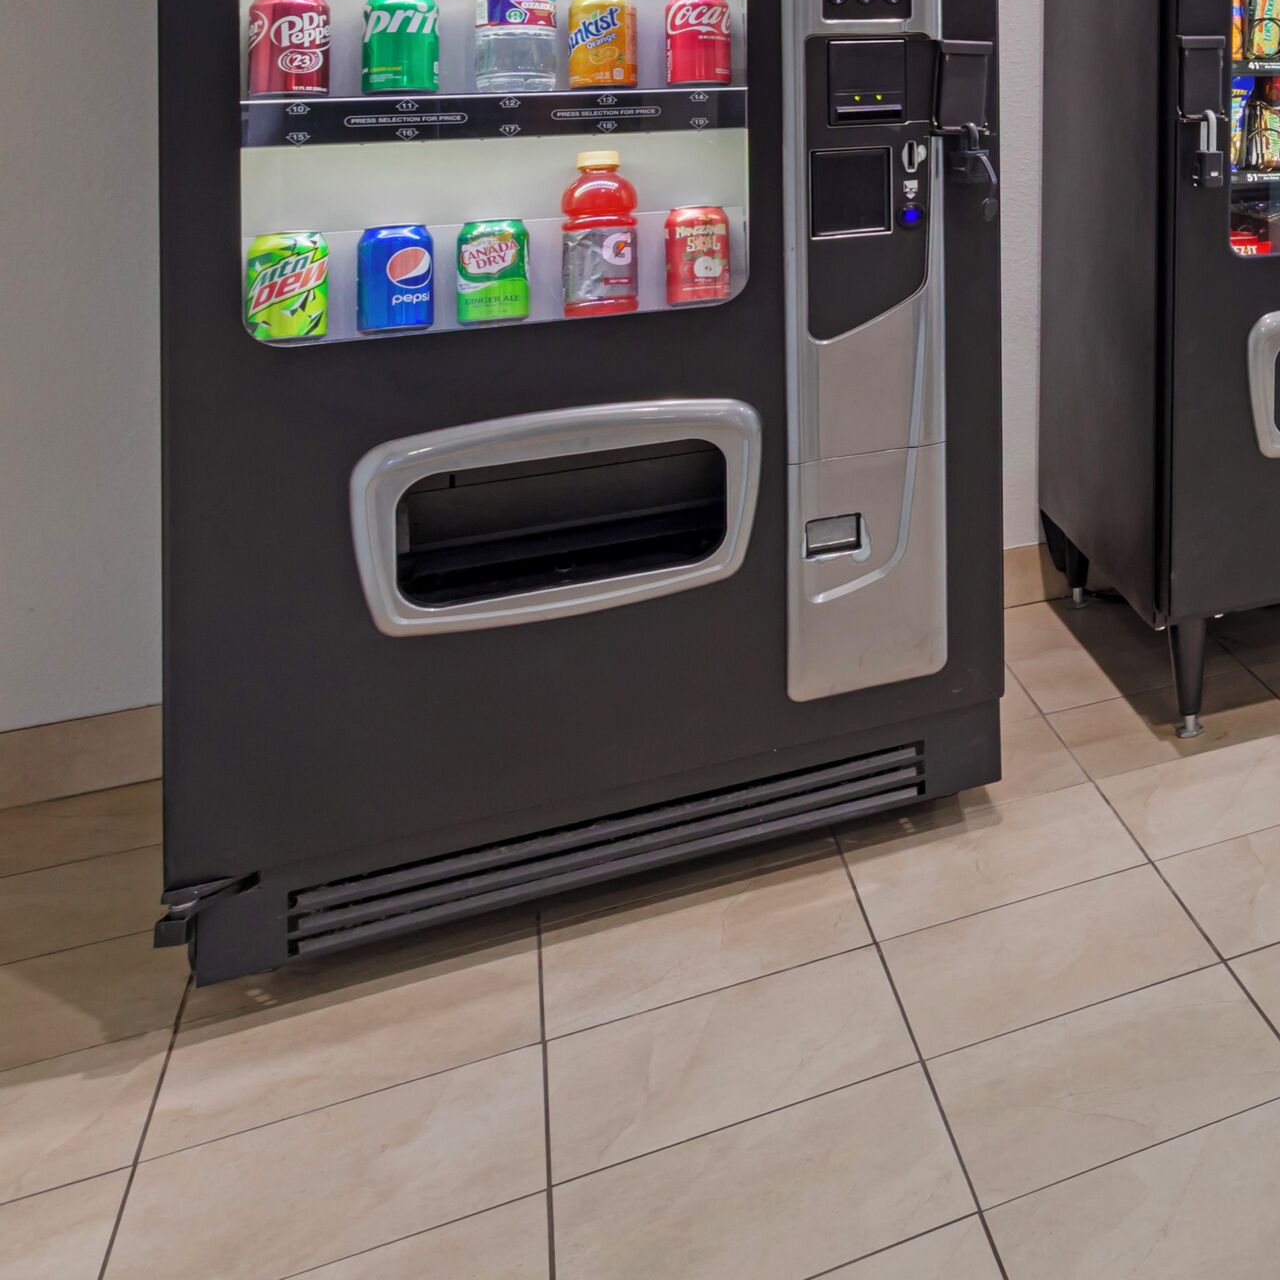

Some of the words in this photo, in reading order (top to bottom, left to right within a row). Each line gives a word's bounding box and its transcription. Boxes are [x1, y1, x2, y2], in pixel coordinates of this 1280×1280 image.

[302, 11, 327, 31] Dr
[274, 16, 331, 47] Peppe
[569, 7, 620, 55] unkist
[587, 33, 617, 48] Orange
[292, 54, 310, 67] 23
[1248, 62, 1260, 70] 41
[1247, 174, 1258, 182] 51
[460, 239, 520, 266] CANADA
[602, 233, 632, 265] G
[475, 253, 508, 270] DRY
[392, 292, 430, 306] pepsi
[465, 295, 499, 305] GINGER
